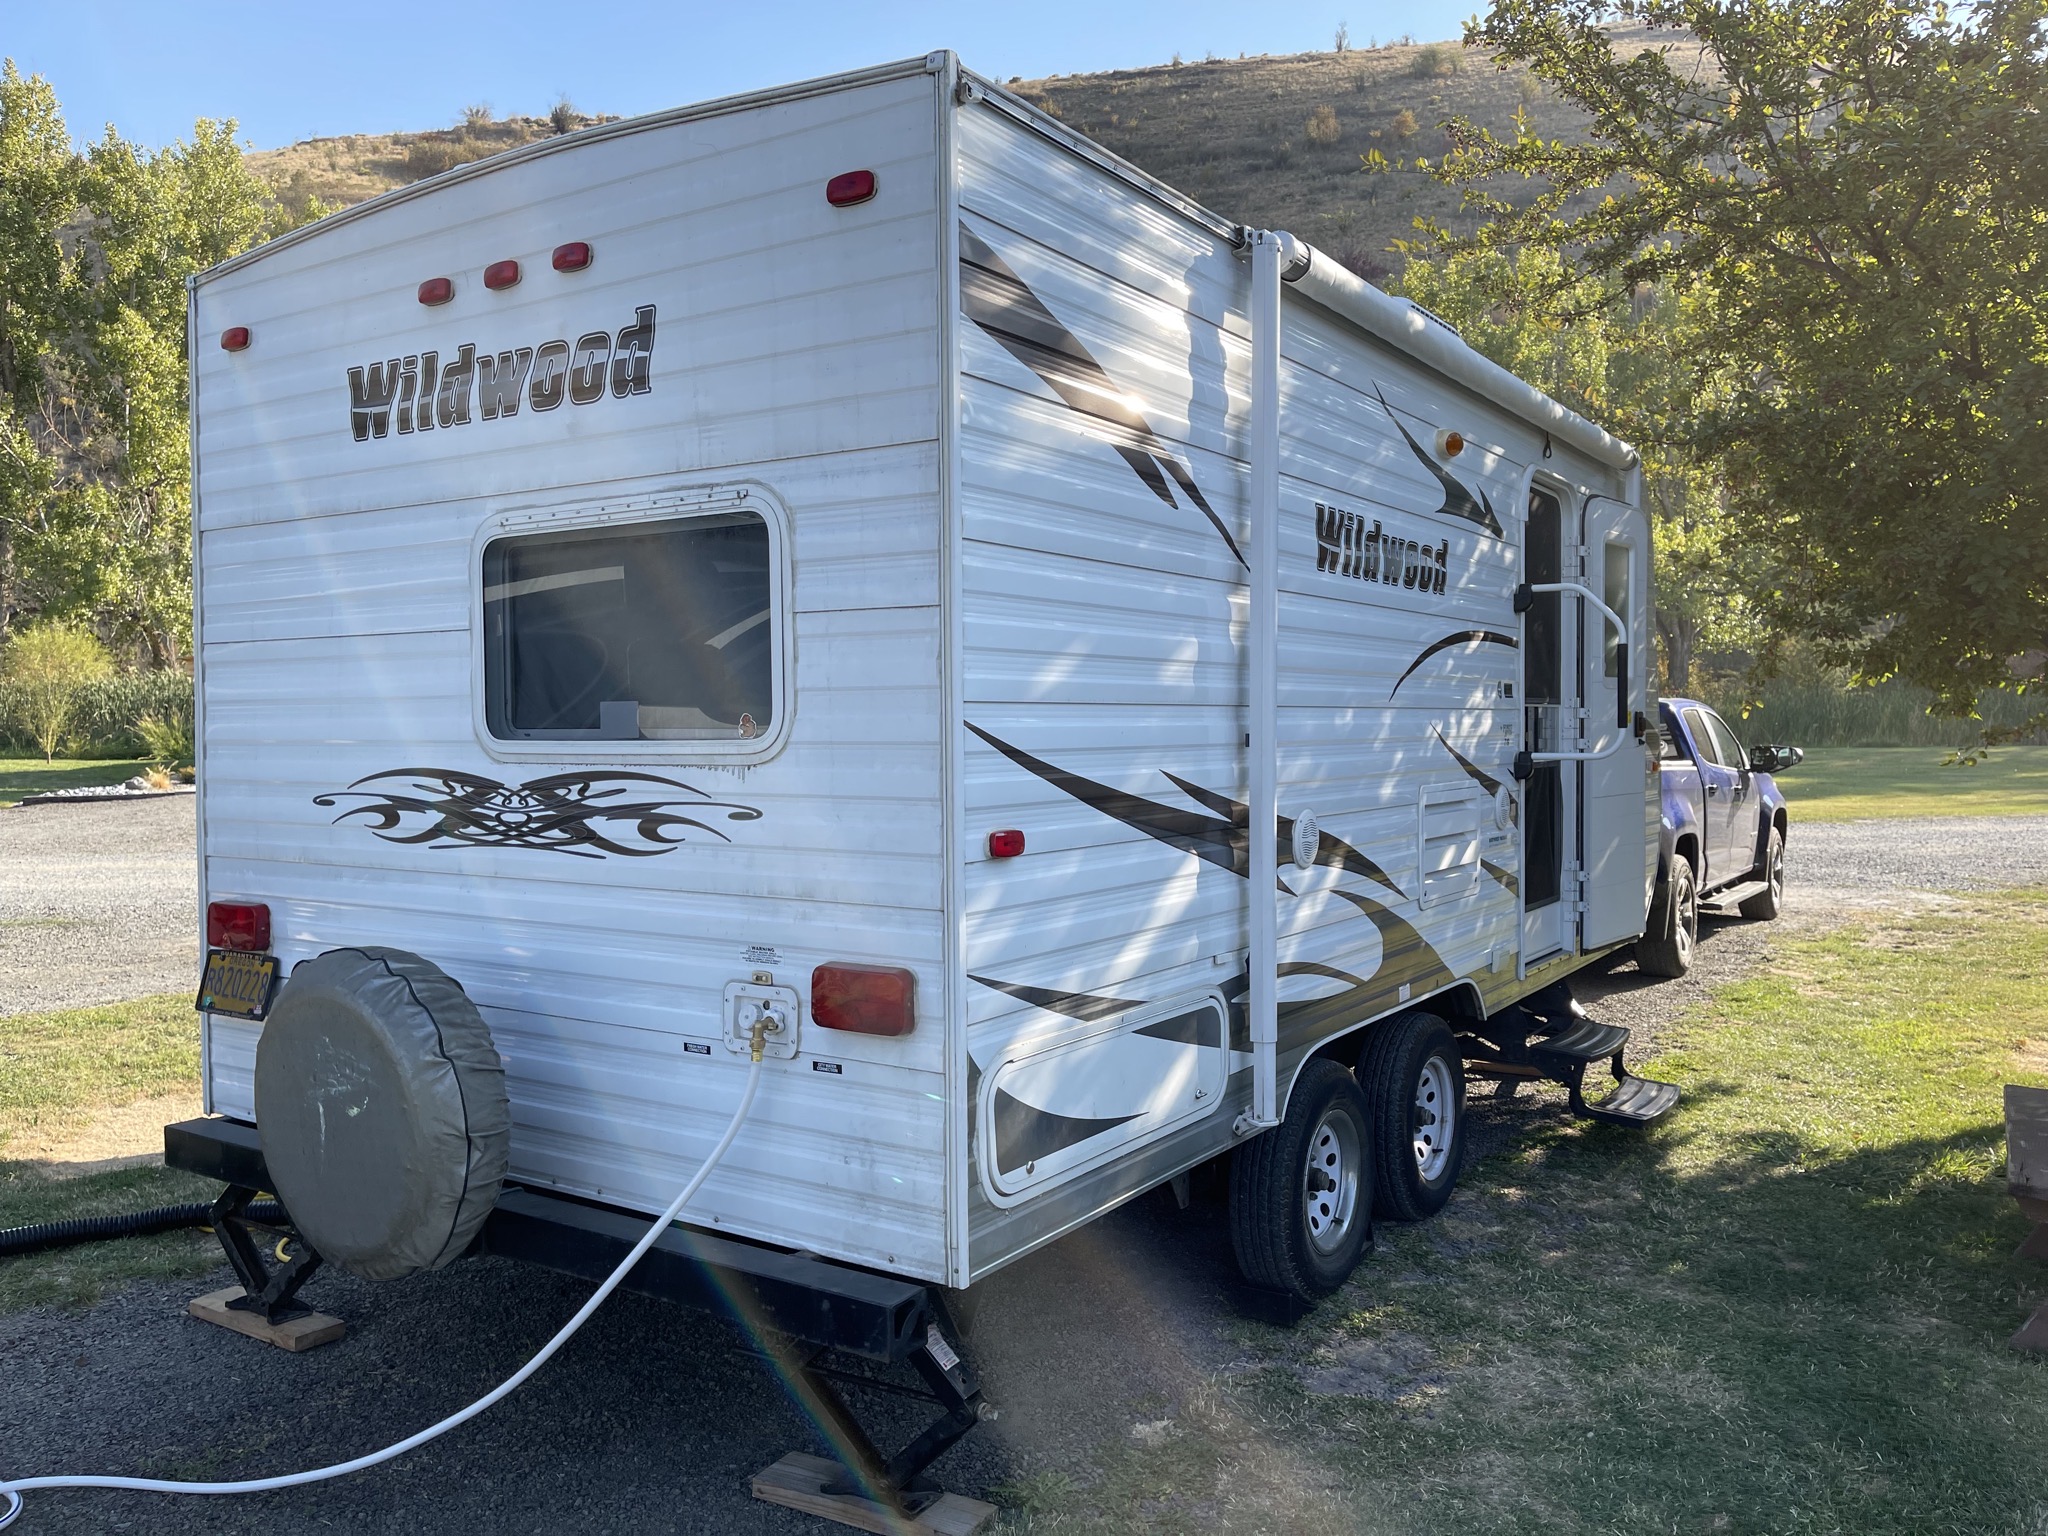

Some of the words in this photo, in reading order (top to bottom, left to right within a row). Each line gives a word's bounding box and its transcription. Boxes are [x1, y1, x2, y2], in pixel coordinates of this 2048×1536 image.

[347, 303, 657, 442] Wildwood
[1315, 502, 1449, 596] Wildwood
[220, 950, 253, 960] GUARANTY
[230, 957, 255, 968] OREGON
[205, 965, 269, 1004] R820228
